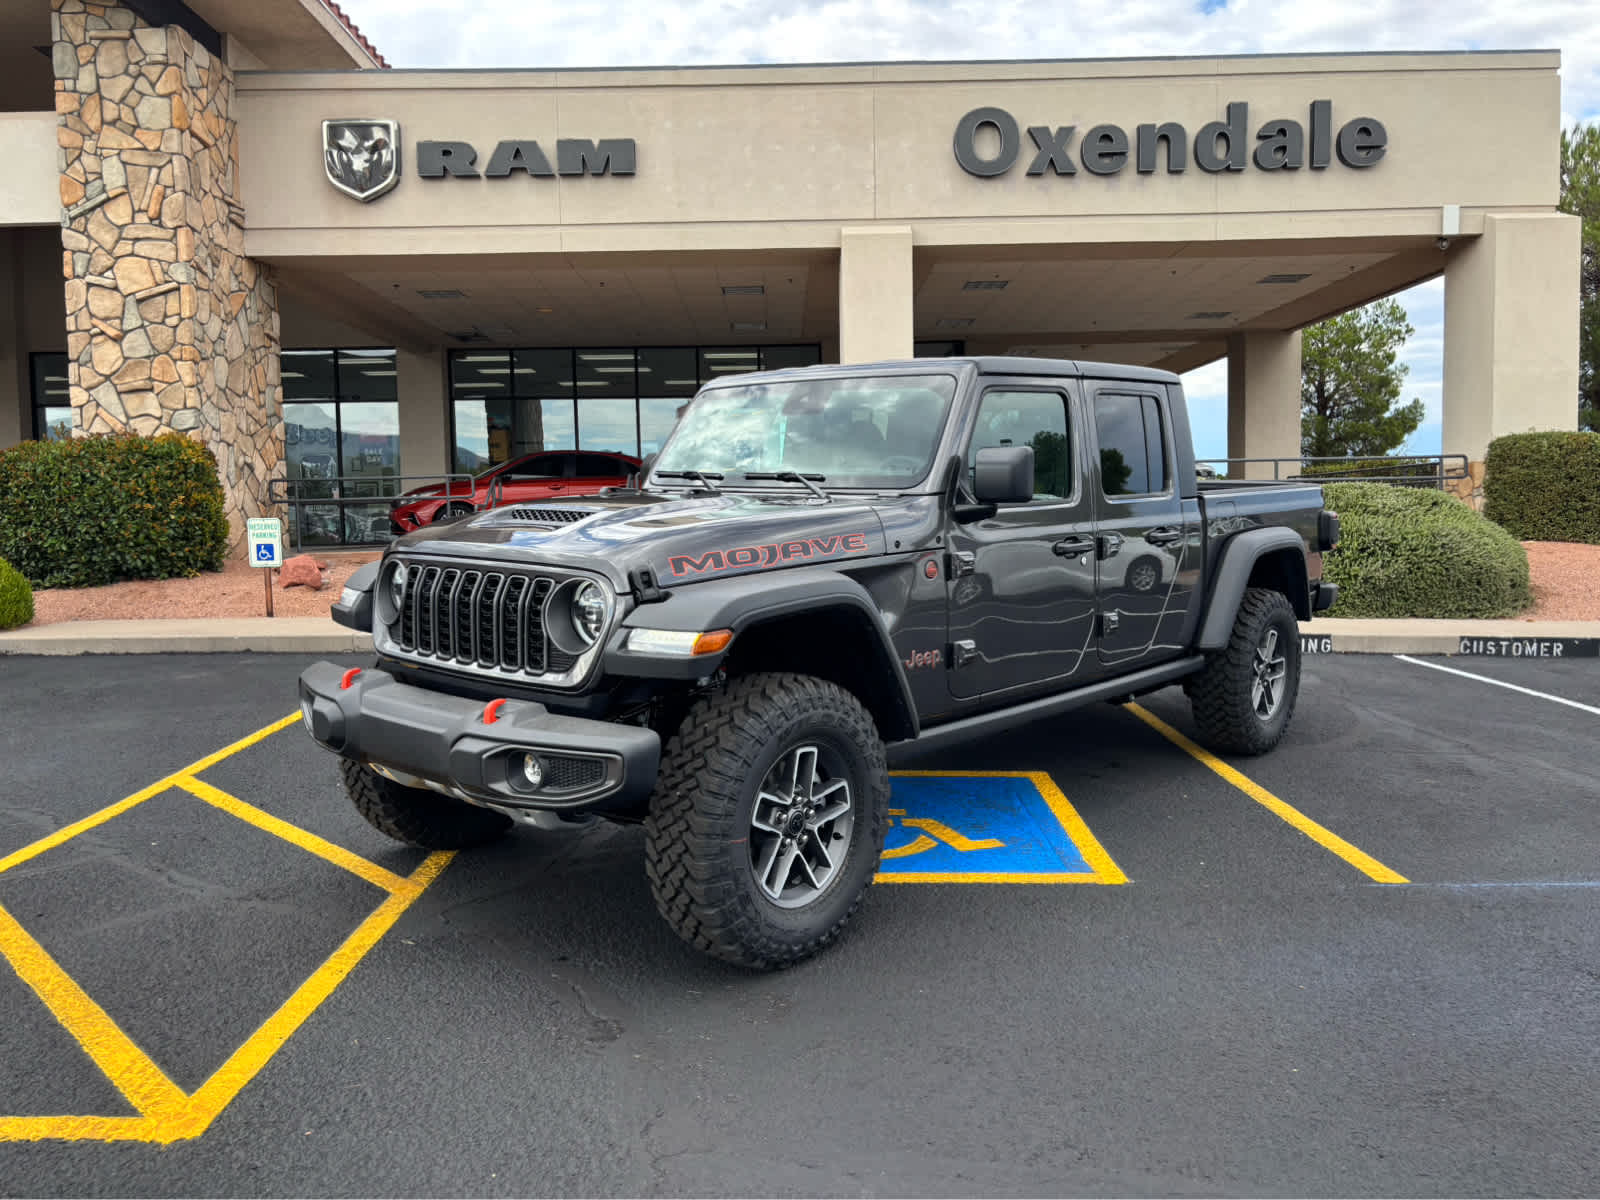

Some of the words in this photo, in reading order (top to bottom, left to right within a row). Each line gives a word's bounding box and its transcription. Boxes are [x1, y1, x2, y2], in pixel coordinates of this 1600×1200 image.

[416, 138, 637, 178] RAM
[953, 99, 1388, 178] Oxendale
[668, 533, 868, 577] MOJAVE
[904, 648, 942, 670] Jeep
[1459, 639, 1564, 657] CUSTOMER
